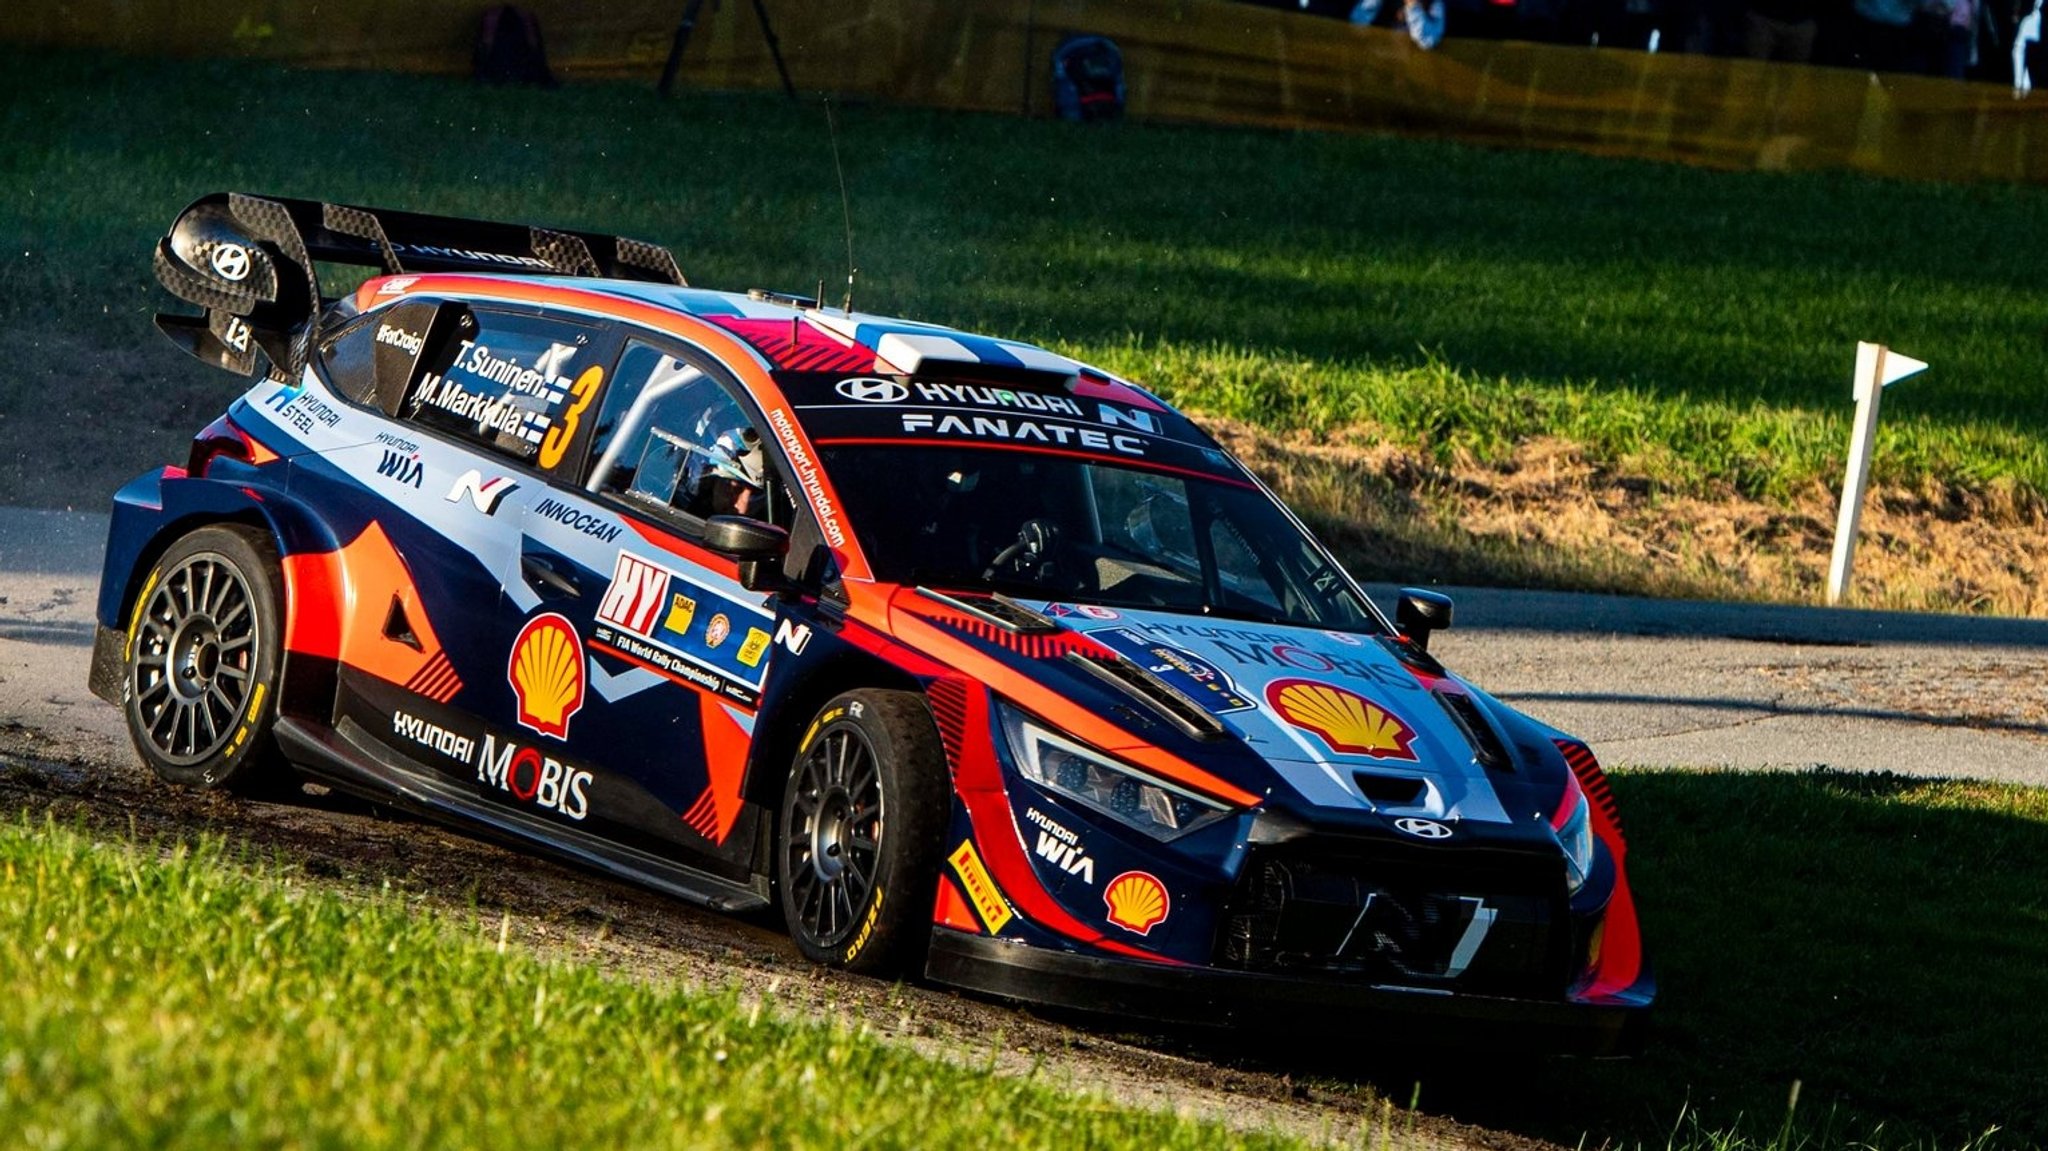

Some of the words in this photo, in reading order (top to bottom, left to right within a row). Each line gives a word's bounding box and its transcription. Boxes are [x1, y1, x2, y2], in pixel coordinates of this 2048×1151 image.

[411, 243, 554, 269] HYUNDAI
[452, 340, 545, 395] T.Suninen
[282, 405, 315, 435] STEEL
[298, 391, 341, 428] HYUNDAI
[414, 372, 522, 435] M.Markkula
[538, 365, 604, 469] 3
[914, 382, 1084, 416] HYUNDAI
[375, 431, 420, 453] HYUNDAI
[901, 413, 1146, 455] FANATEC
[771, 408, 846, 547] motorsport.hyundai.com
[534, 498, 622, 543] INNOCEAN
[599, 552, 669, 637] HY
[1134, 622, 1306, 648] HYUNDAI
[616, 636, 631, 651] FIA
[630, 639, 652, 660] World
[651, 651, 673, 670] Rally
[670, 659, 720, 691] Championship
[1210, 639, 1420, 691] MOBIS
[393, 710, 475, 764] HYUNDAI
[477, 733, 594, 821] MOBIS
[1026, 807, 1079, 846] HYUNDAI
[958, 850, 1004, 924] PIRELLI
